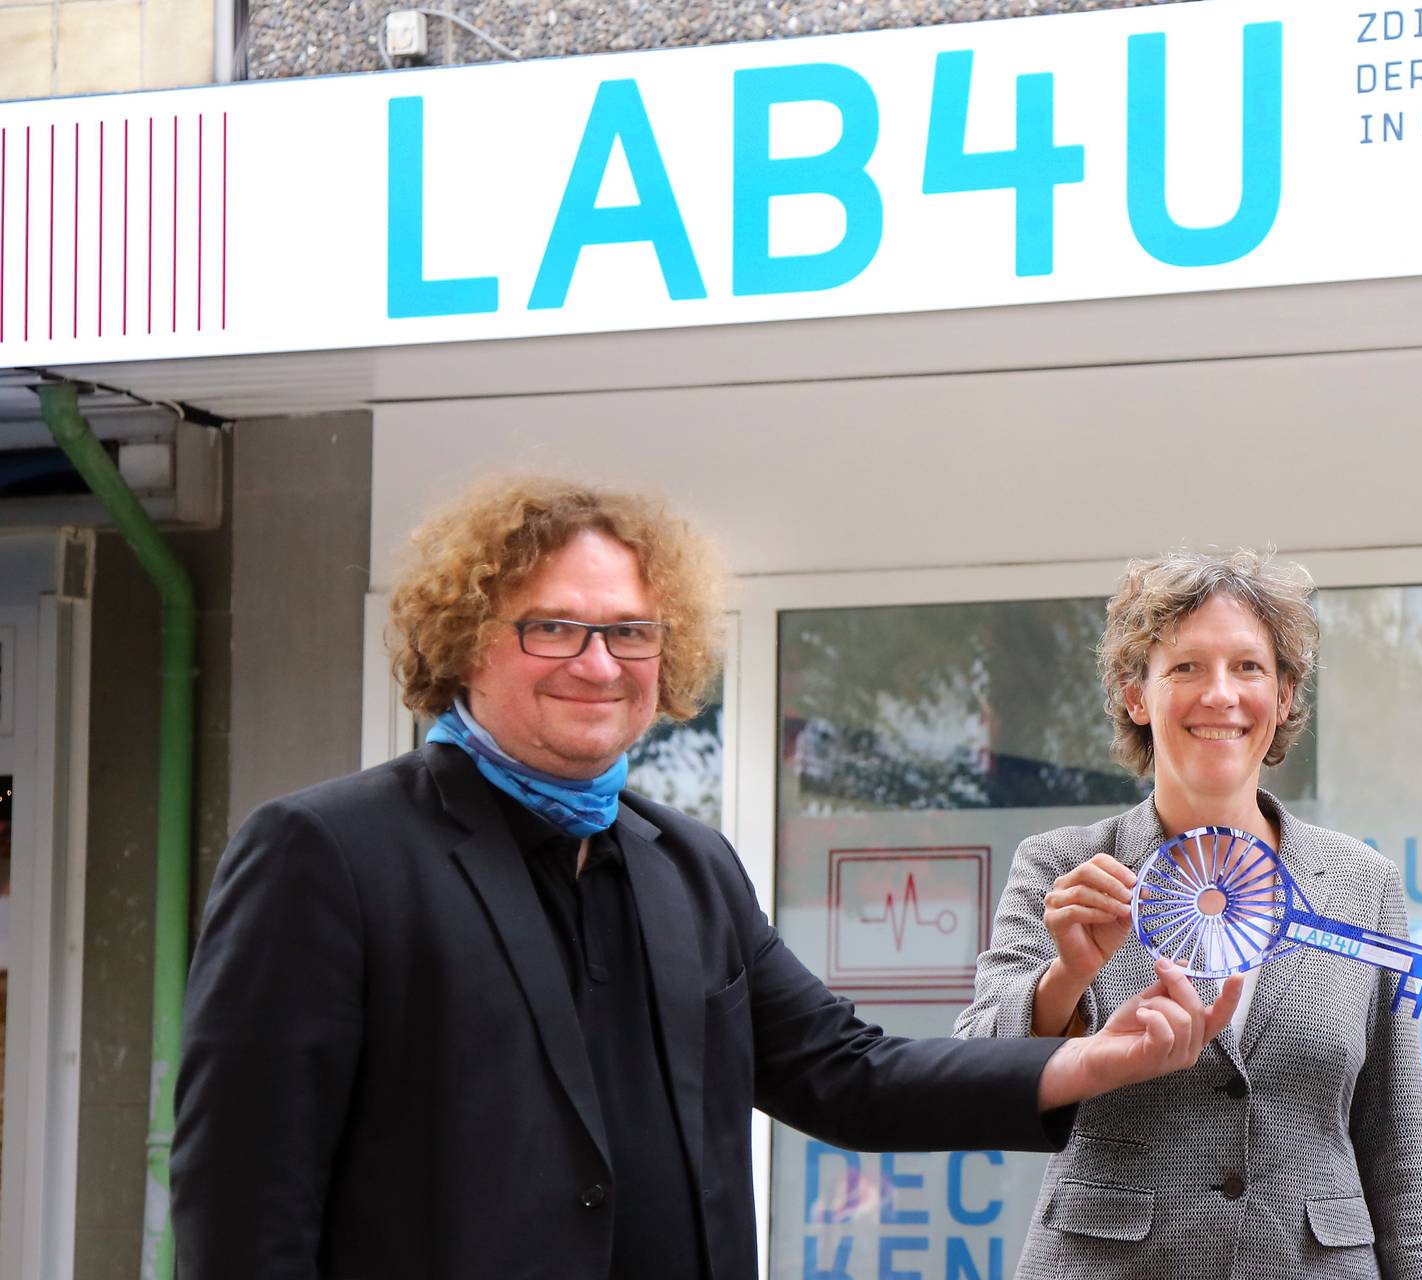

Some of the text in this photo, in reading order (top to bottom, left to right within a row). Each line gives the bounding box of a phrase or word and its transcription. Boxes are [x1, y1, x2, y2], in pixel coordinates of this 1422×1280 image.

[1360, 112, 1404, 144] IN
[387, 20, 1284, 319] LAB4U
[1293, 921, 1362, 957] LAB4U
[804, 1138, 1004, 1227] DEC
